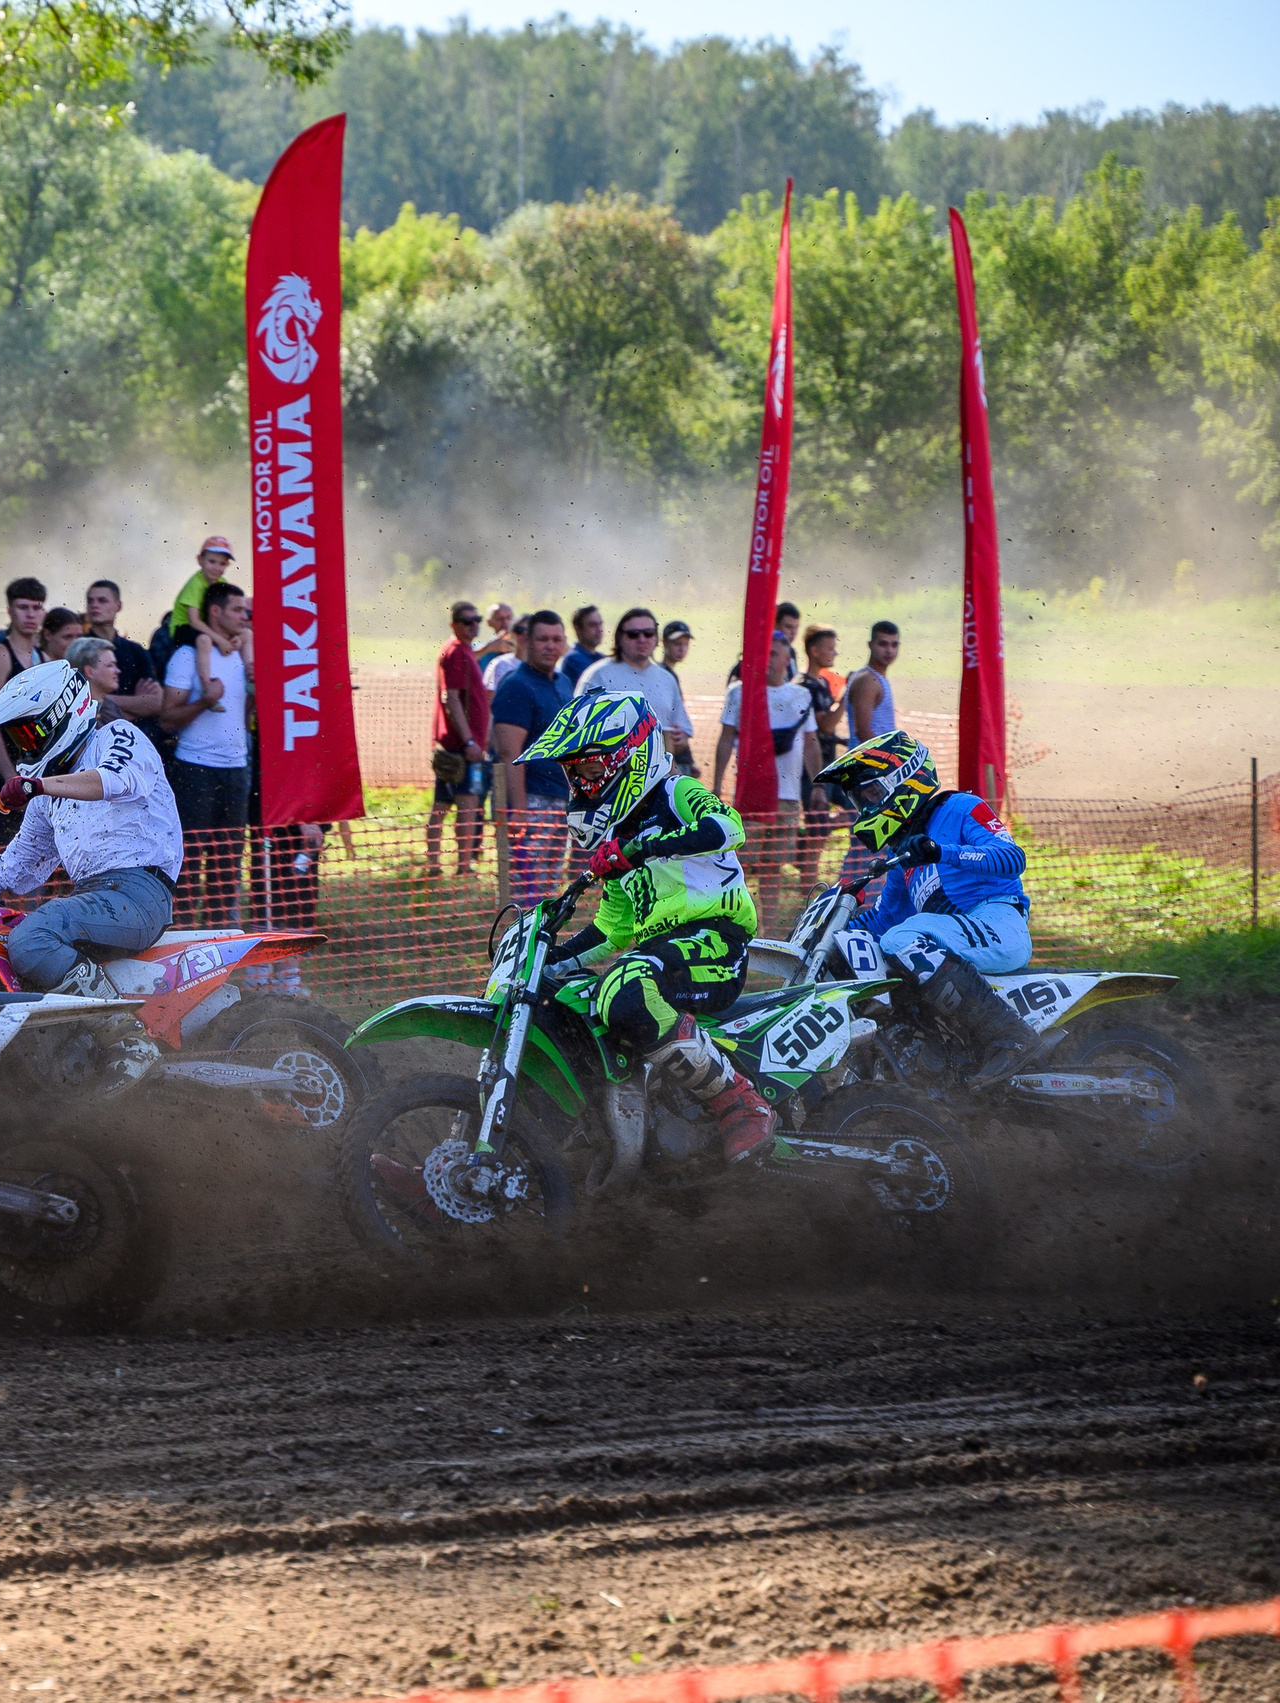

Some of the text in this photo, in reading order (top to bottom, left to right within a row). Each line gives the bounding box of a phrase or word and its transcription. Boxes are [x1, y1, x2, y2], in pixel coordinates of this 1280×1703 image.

[254, 410, 273, 553] MOTOR OIL
[750, 444, 775, 573] MOTOR OIL
[277, 393, 320, 751] TAKAYAMA
[46, 674, 83, 728] 100%
[893, 750, 925, 787] 100%
[169, 945, 224, 982] 737
[177, 980, 200, 993] KSENIA
[1006, 978, 1072, 1017] 161
[1043, 1005, 1059, 1015] MAX
[772, 1006, 845, 1069] 505
